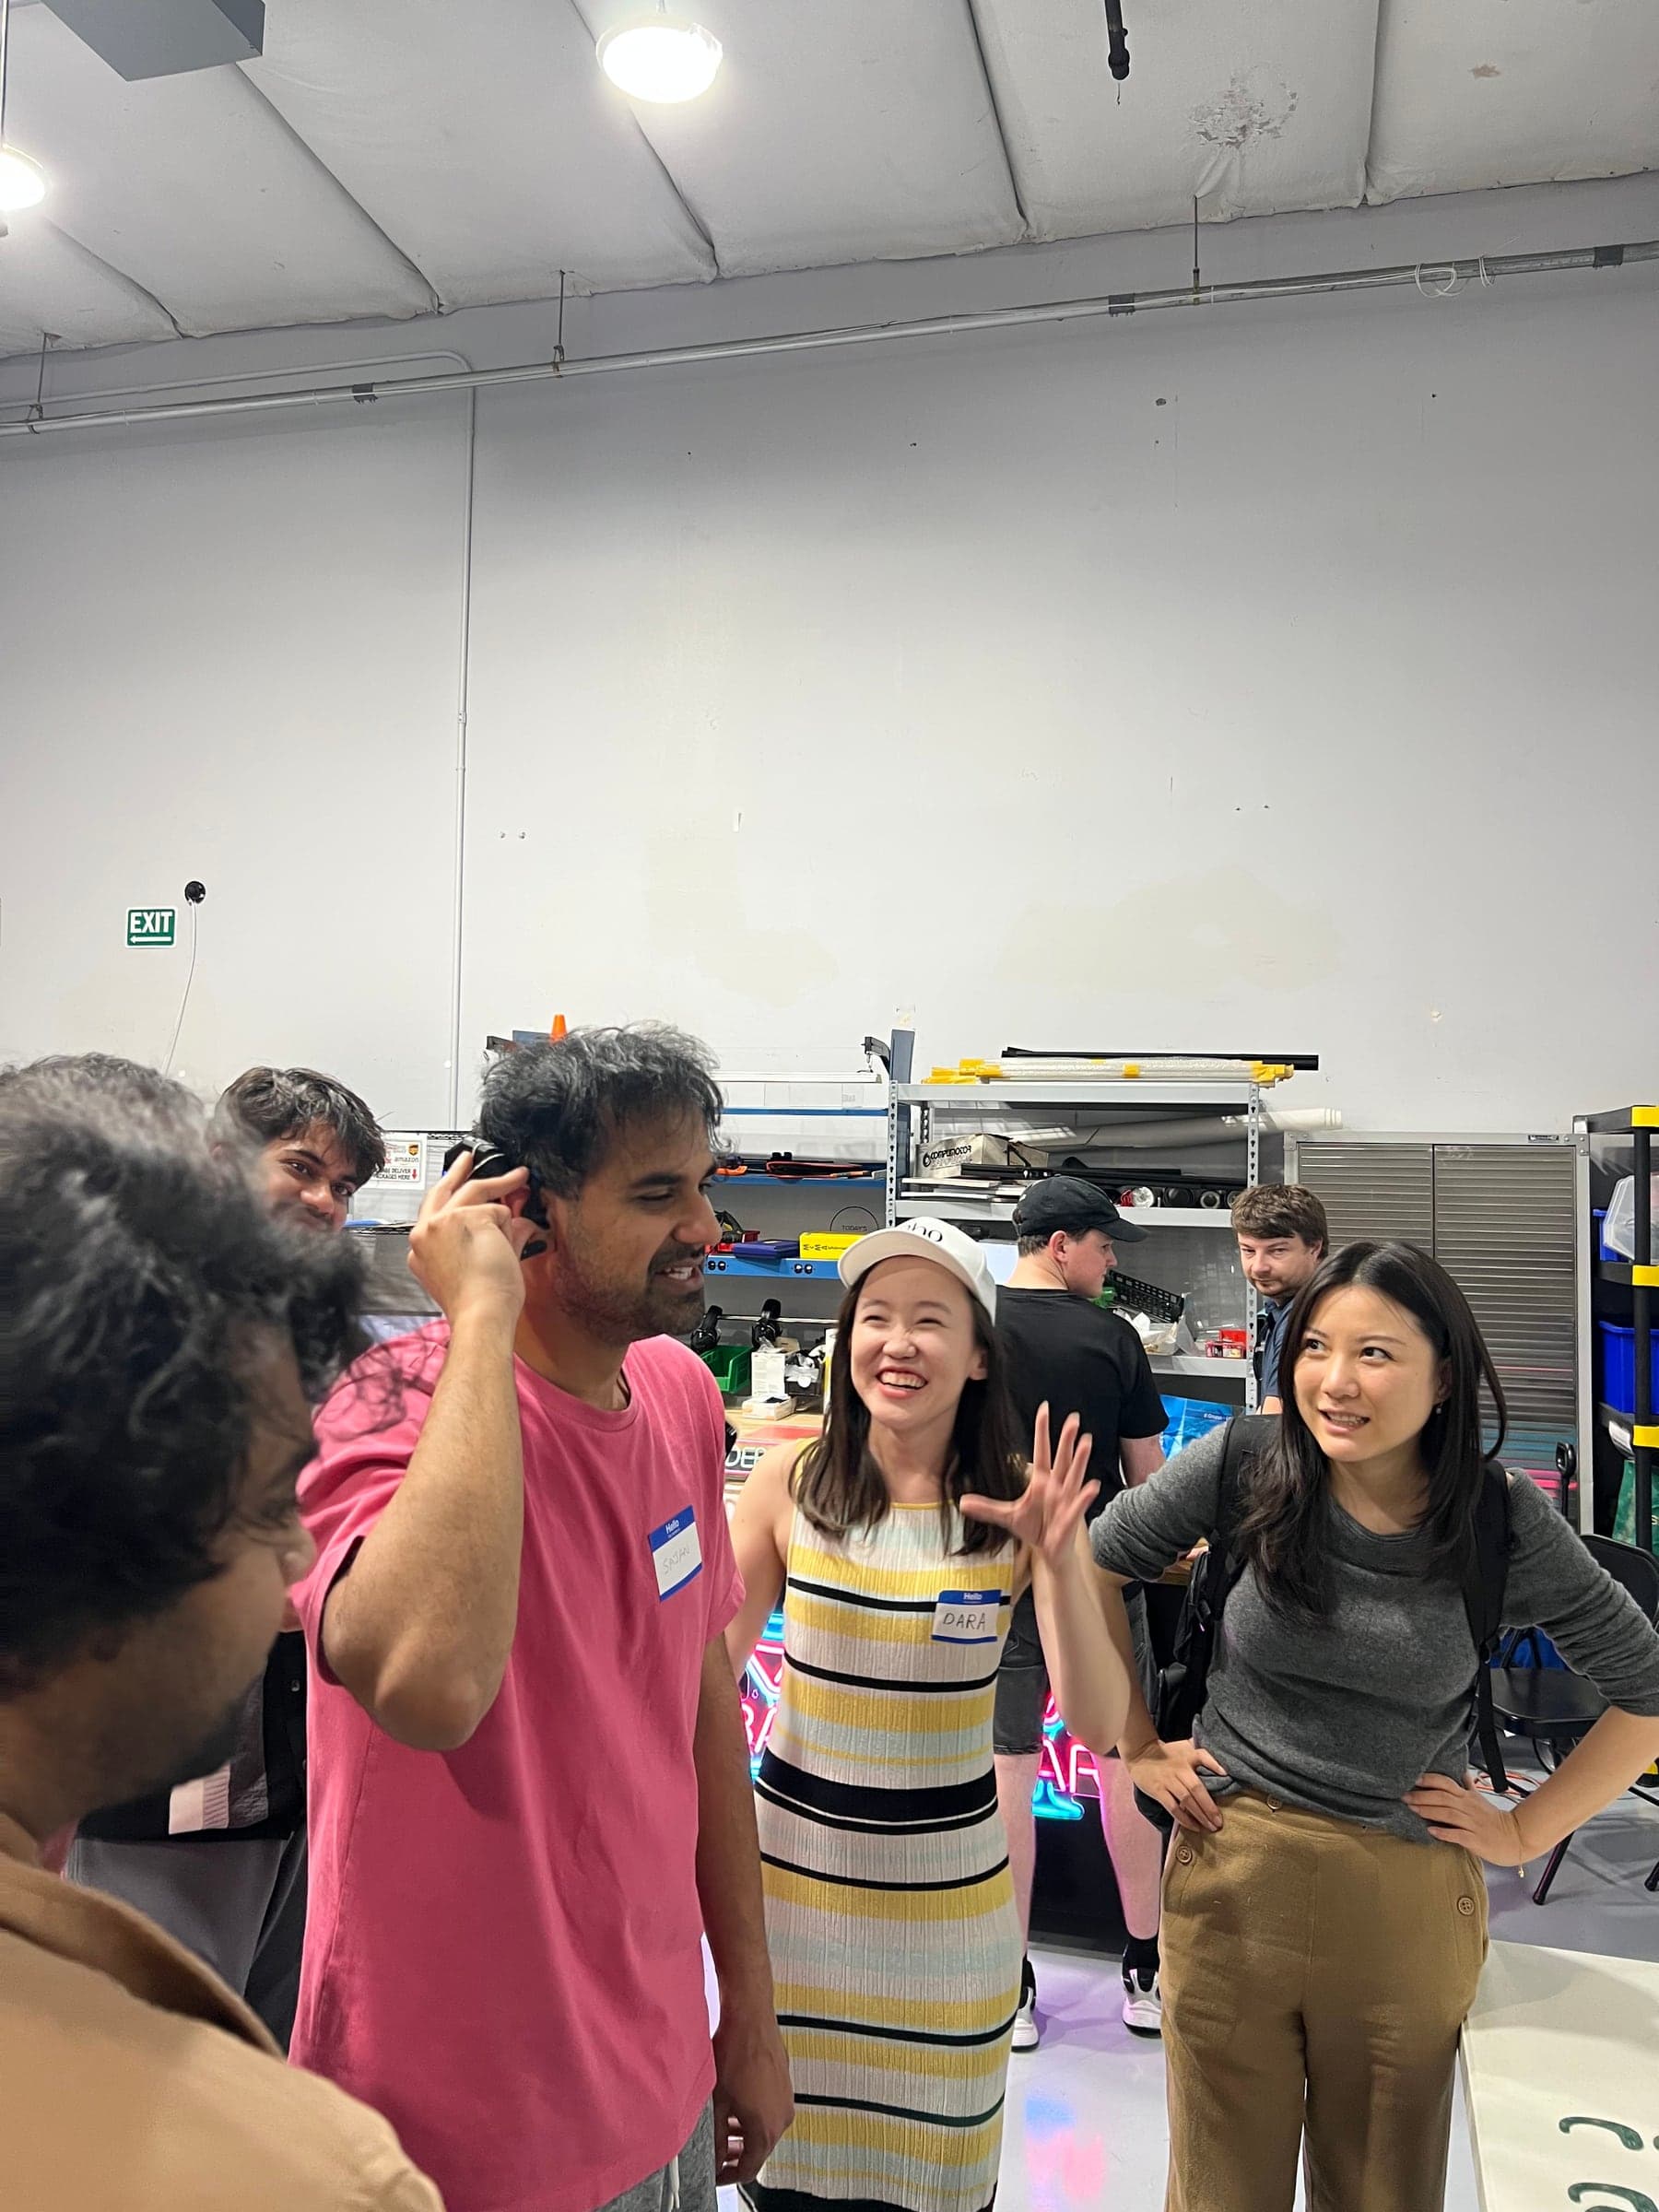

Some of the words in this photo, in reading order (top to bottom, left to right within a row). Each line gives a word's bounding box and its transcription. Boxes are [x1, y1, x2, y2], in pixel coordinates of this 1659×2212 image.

[130, 912, 173, 934] EXIT
[665, 1519, 680, 1535] Hello
[963, 1592, 983, 1601] Hello
[943, 1612, 987, 1632] DARA
